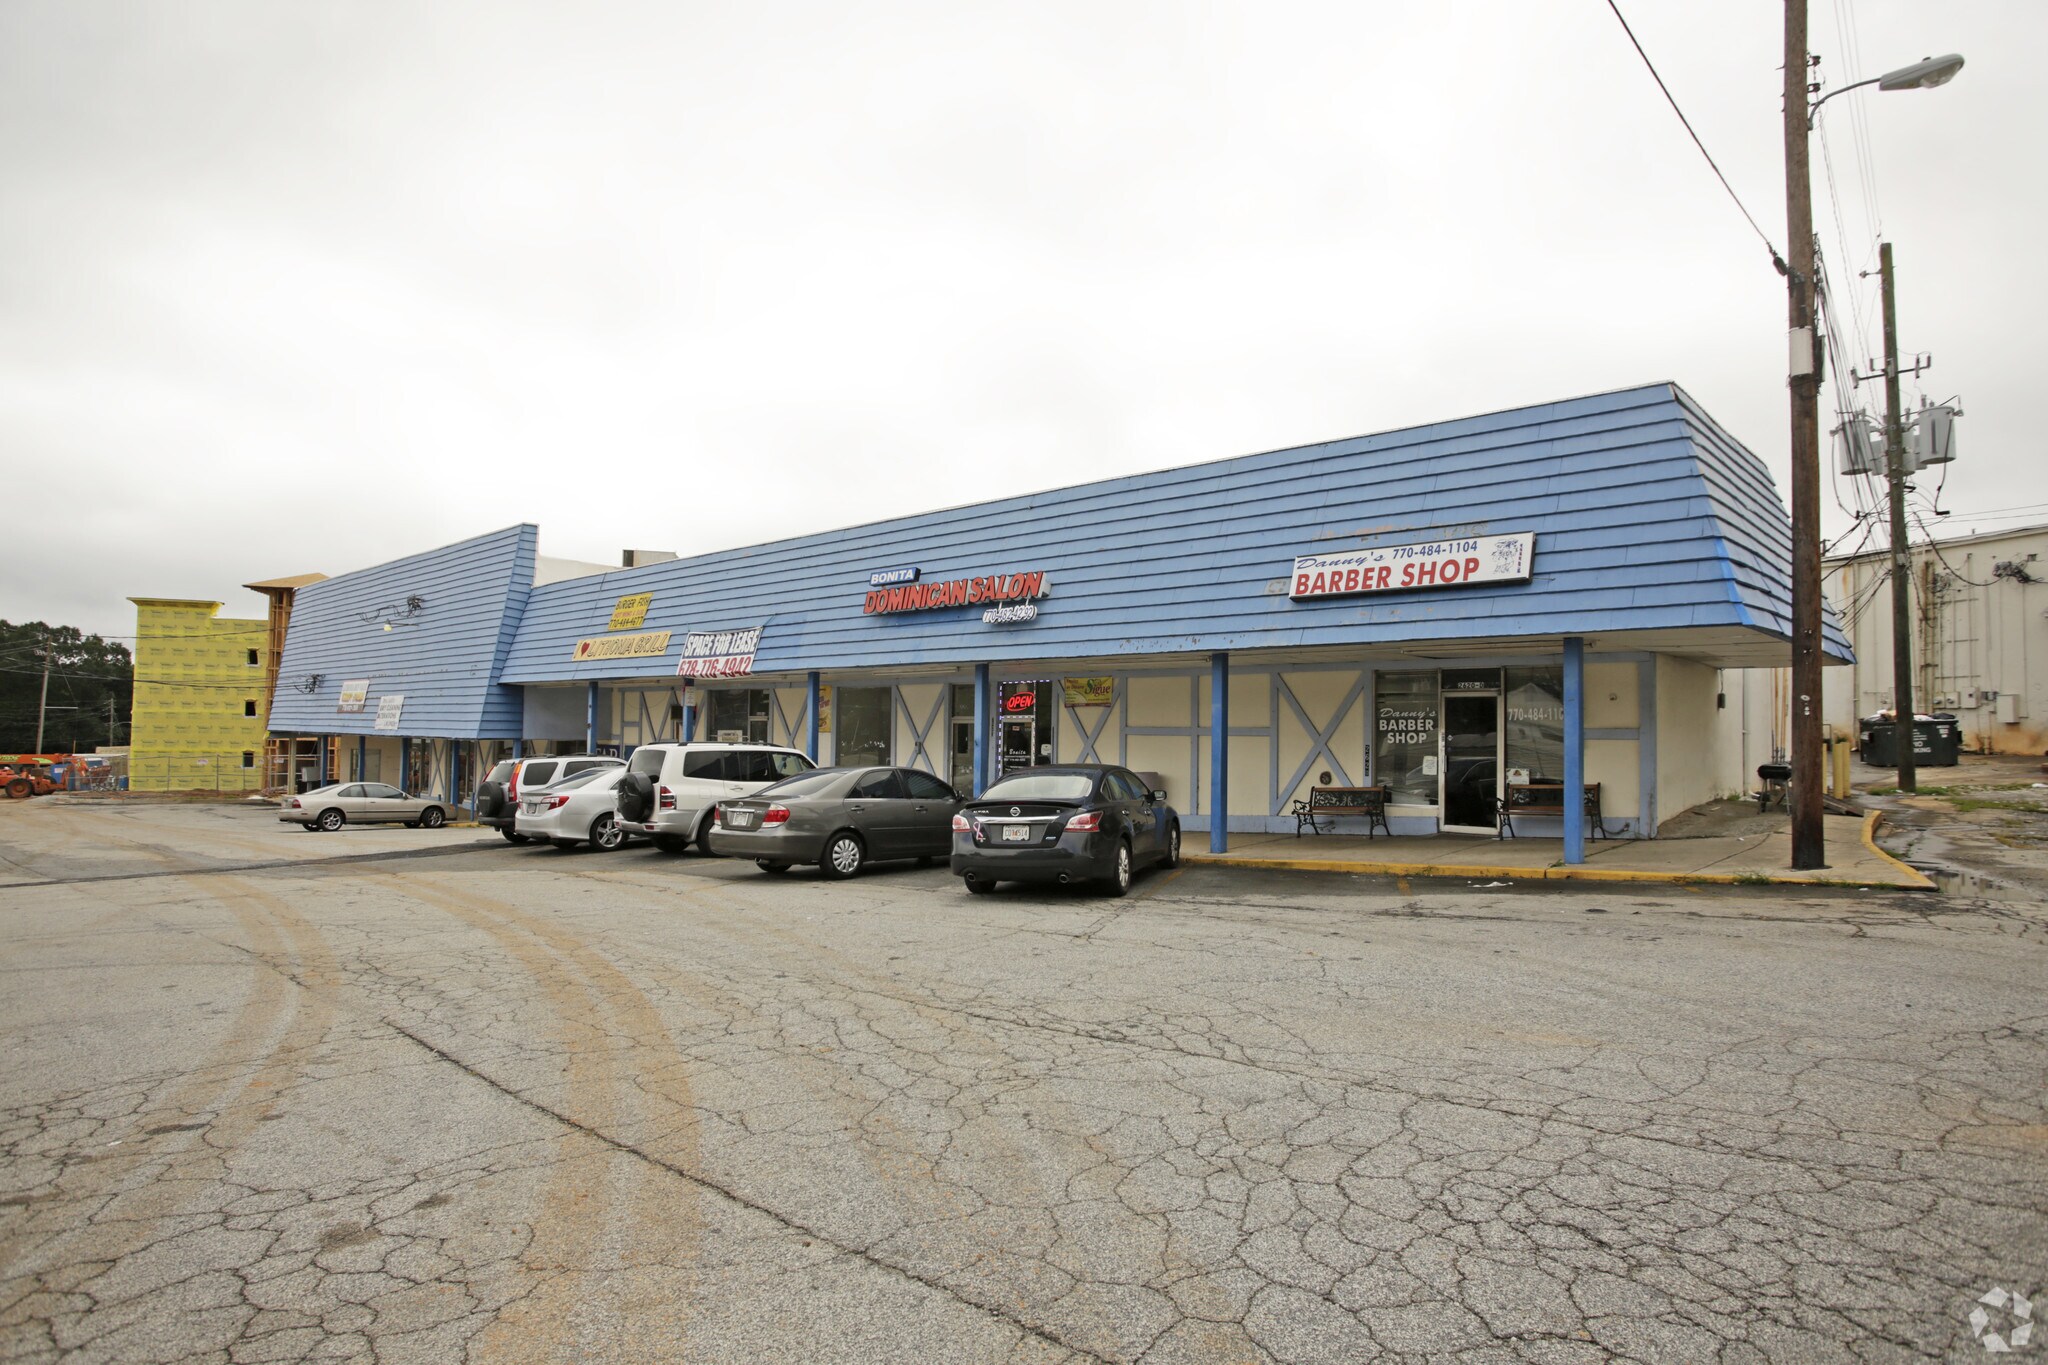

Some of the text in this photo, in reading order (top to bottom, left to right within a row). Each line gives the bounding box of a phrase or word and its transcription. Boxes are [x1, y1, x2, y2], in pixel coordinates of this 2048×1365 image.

[1296, 540, 1479, 570] Danny's 770-484-1104
[870, 568, 915, 585] BONITA
[1295, 557, 1480, 595] BARBER SHOP
[863, 570, 1044, 615] DOMINICAN SALON
[684, 627, 759, 657] SPACE FOR LEASE
[678, 656, 752, 678] 678-776-4942
[1008, 695, 1033, 708] OPEN
[1379, 707, 1564, 721] Danny's 770-484-110
[1379, 719, 1434, 731] BARBER
[1387, 732, 1428, 744] SHOP
